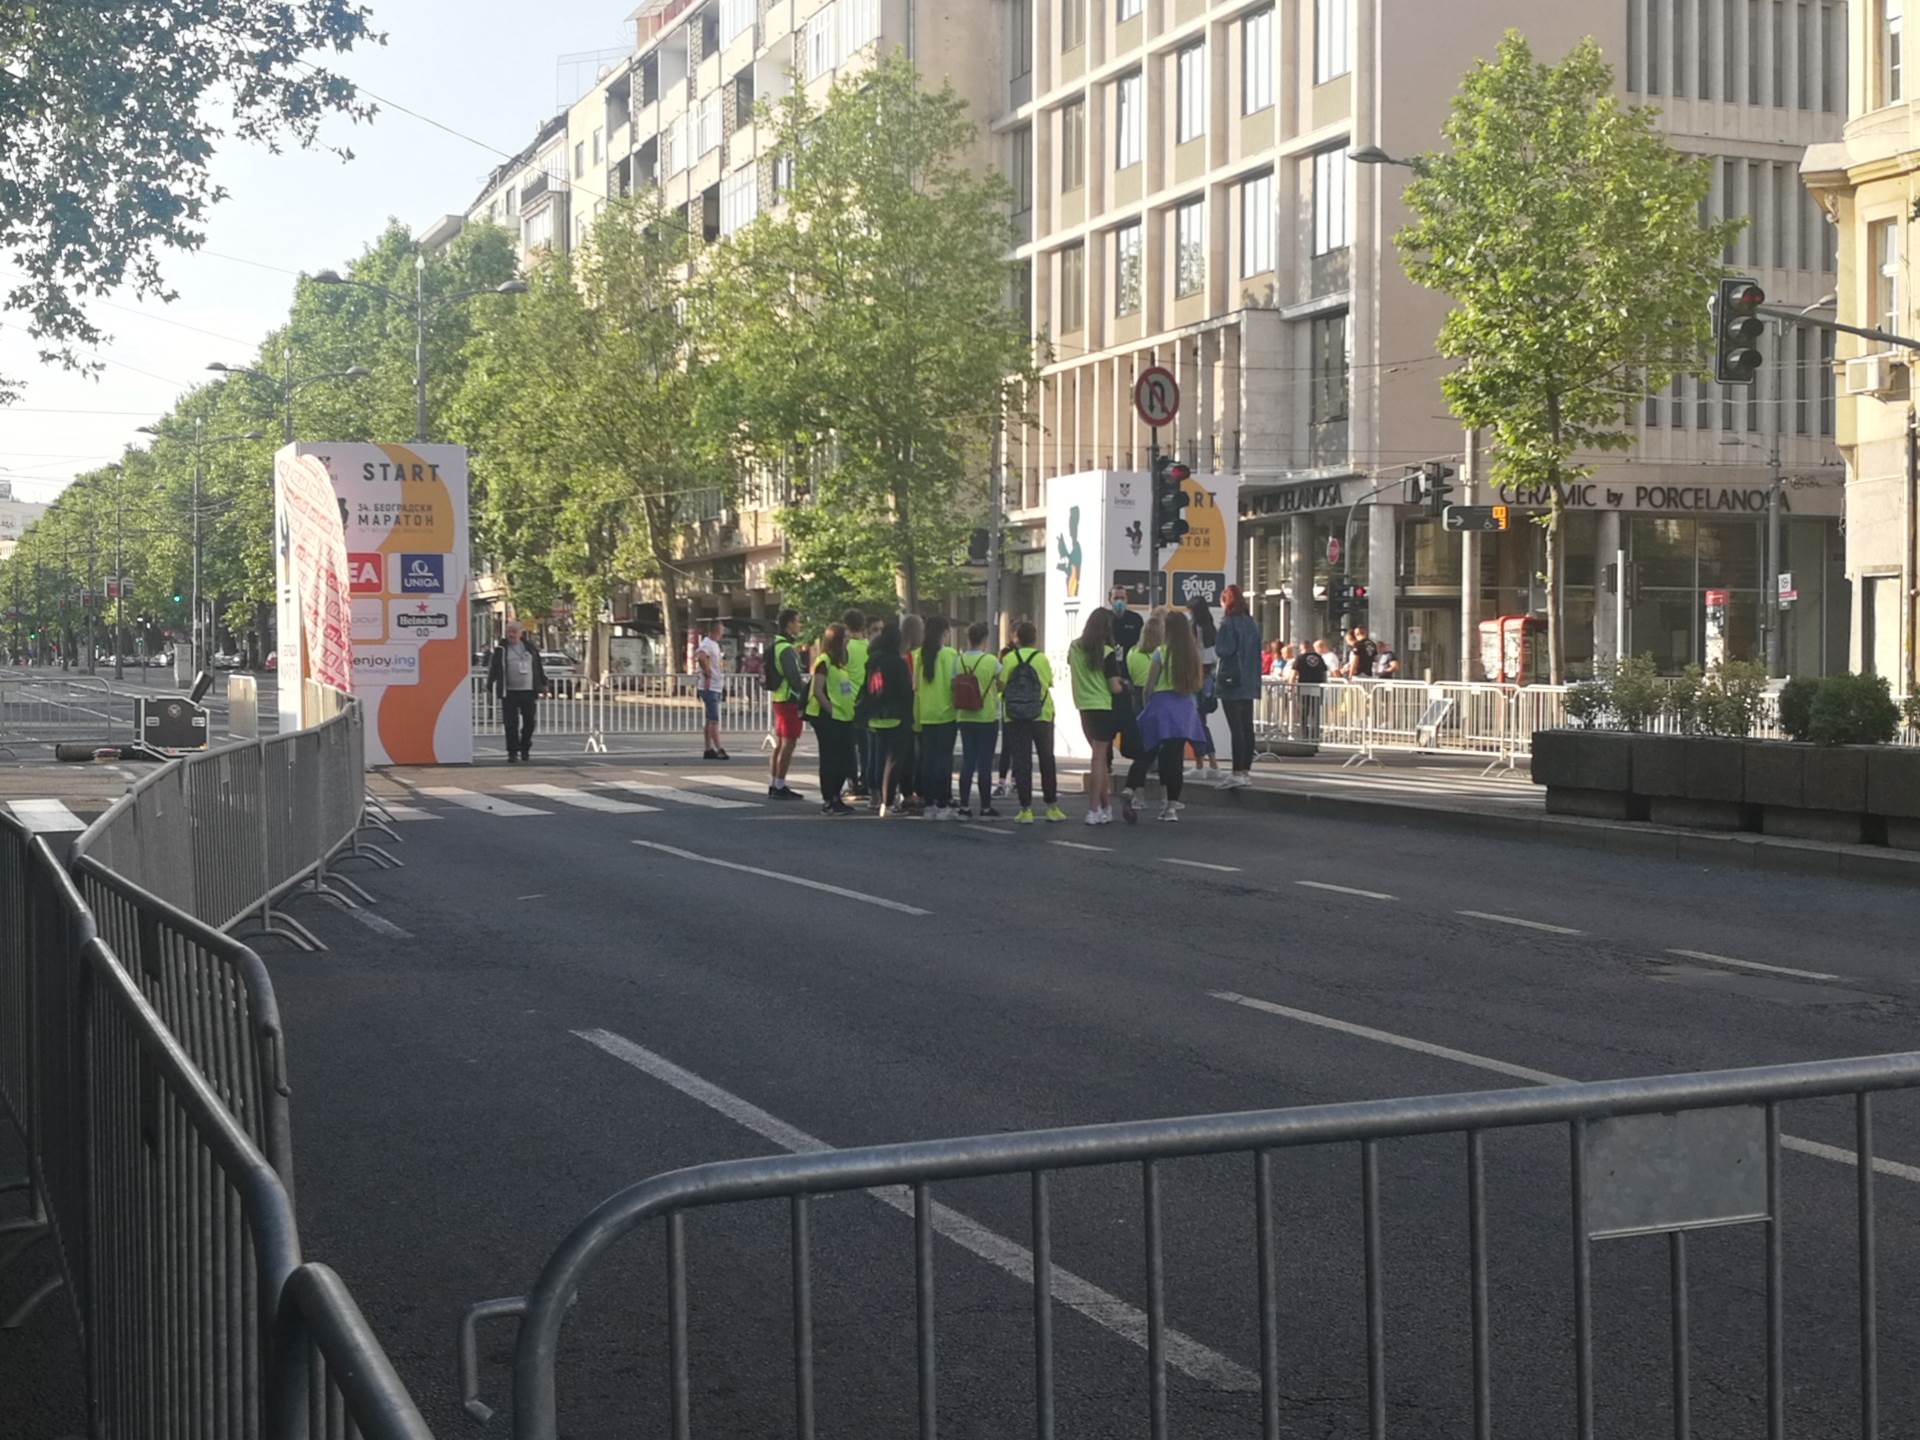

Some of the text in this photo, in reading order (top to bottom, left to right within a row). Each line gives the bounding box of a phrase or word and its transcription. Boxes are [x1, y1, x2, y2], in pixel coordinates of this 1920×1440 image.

[362, 462, 440, 483] START
[1499, 483, 1791, 513] CERAMIC by PORCELANOSA
[373, 503, 433, 514] БЕОГРАДСКИ
[357, 514, 433, 527] МАРАТОН
[403, 578, 441, 588] UNIQA
[352, 654, 416, 668] enjoy.ing
